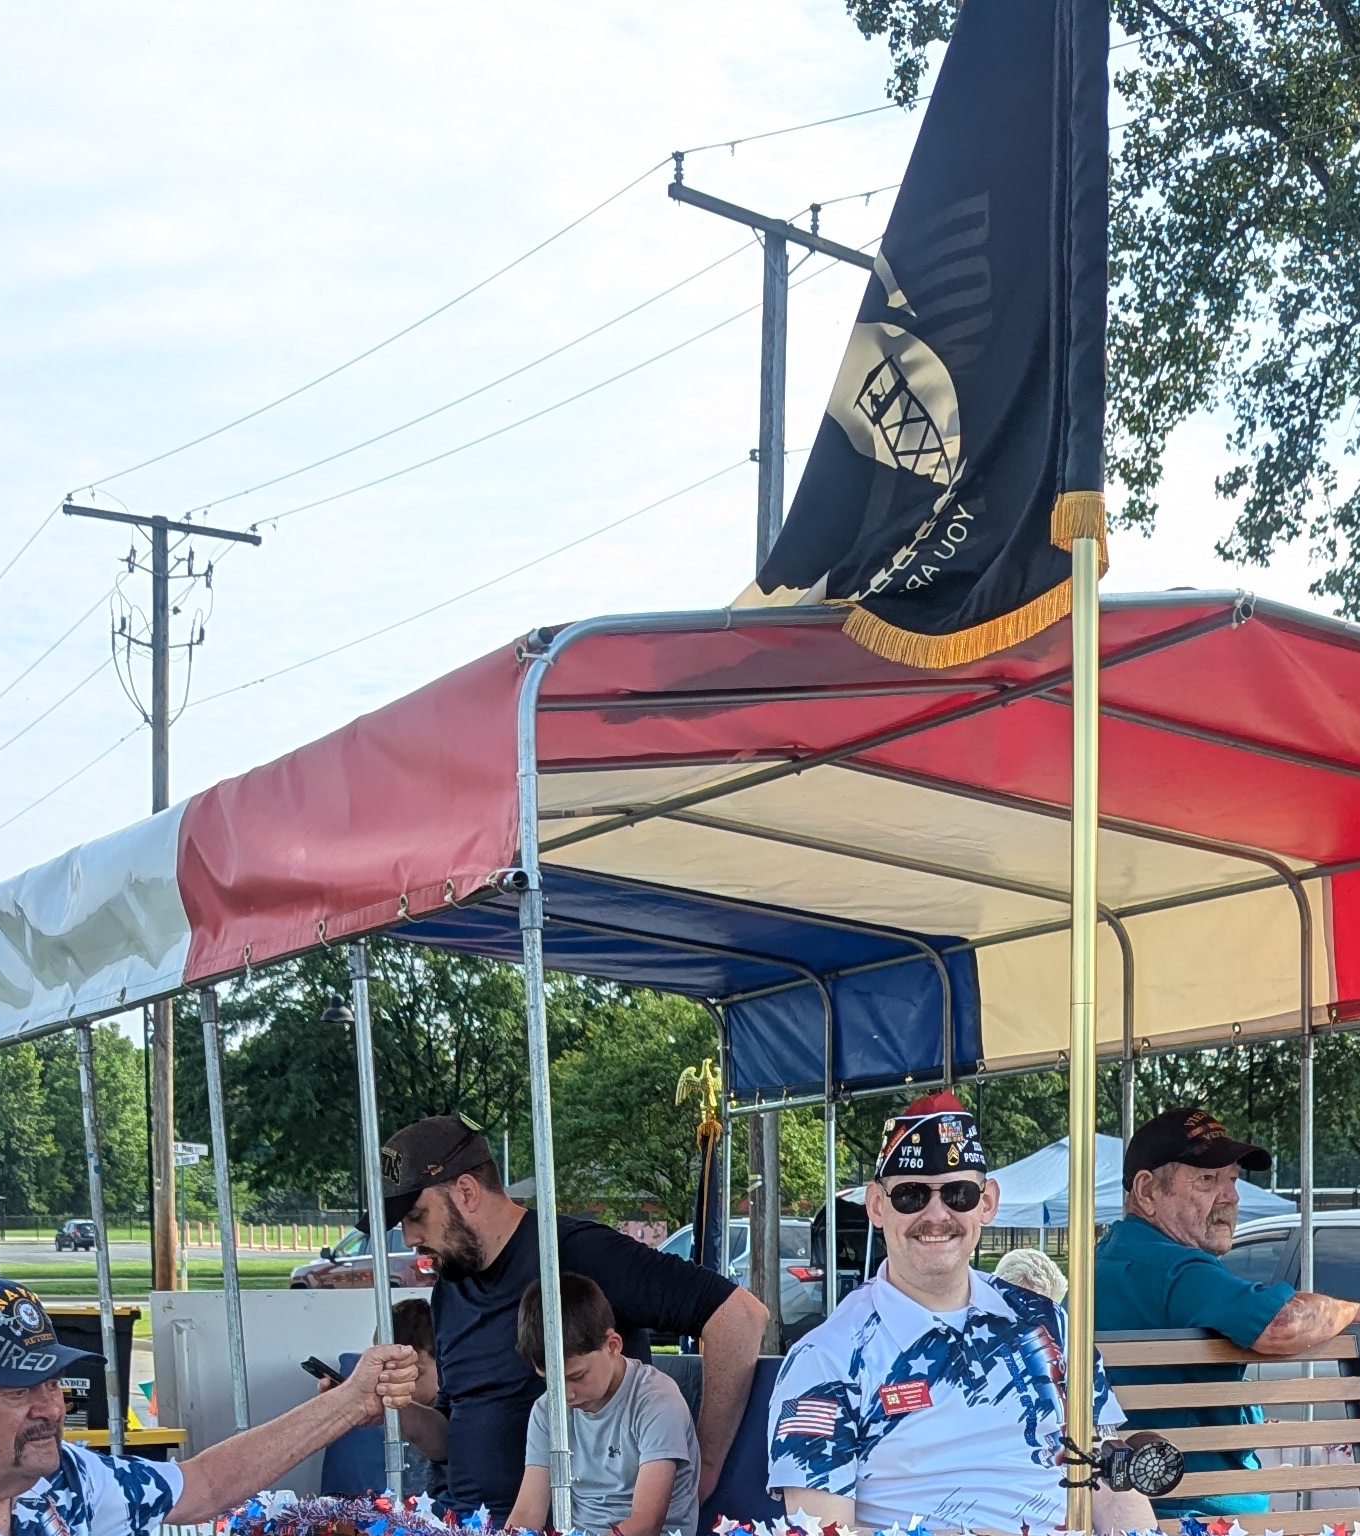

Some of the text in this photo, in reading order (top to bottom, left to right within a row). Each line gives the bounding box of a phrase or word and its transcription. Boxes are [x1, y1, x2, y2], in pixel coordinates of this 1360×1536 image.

[901, 1146, 922, 1157] VFW
[898, 1157, 924, 1168] 7760
[76, 1388, 88, 1396] XL
